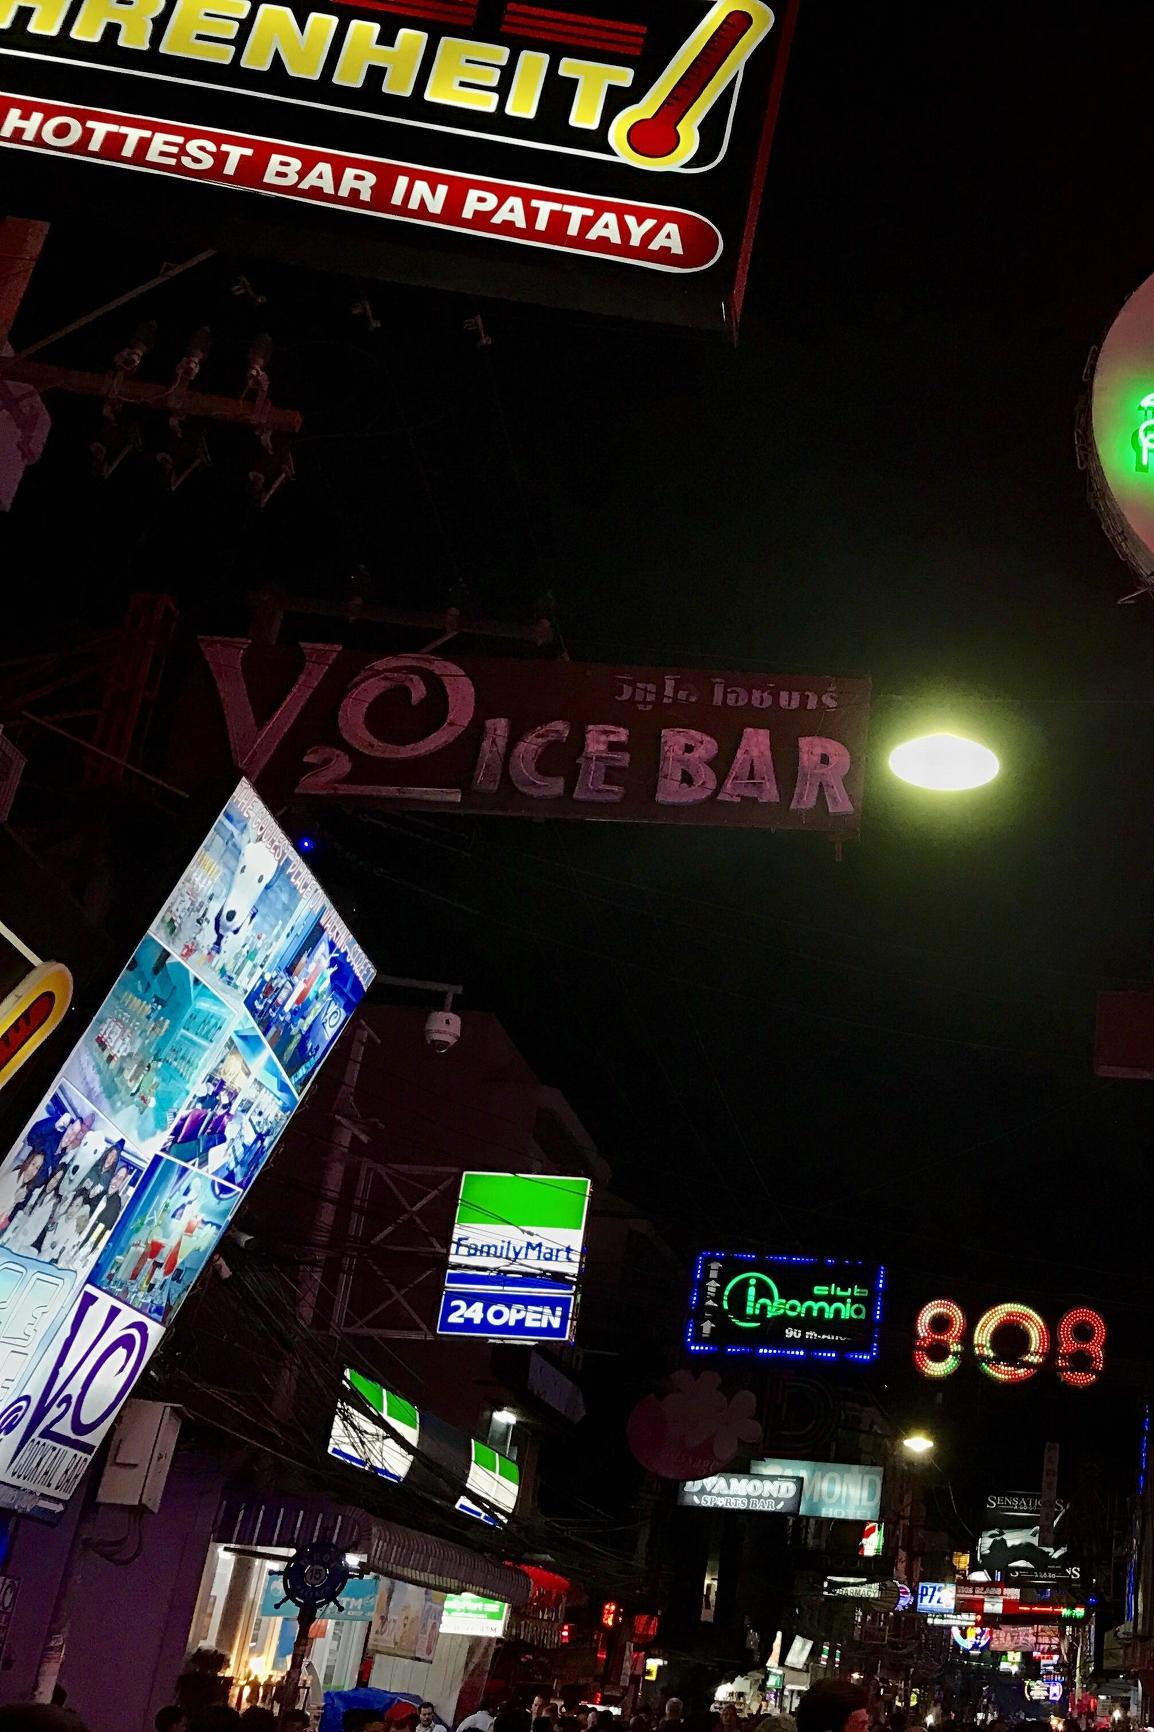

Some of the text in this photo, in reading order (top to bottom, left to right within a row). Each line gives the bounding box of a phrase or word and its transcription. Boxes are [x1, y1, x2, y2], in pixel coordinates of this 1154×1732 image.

[0, 107, 685, 255] HOTTEST BAR IN PATTAYA
[469, 718, 630, 801] ICE
[655, 727, 855, 814] BAR
[454, 1236, 574, 1262] FamilyMart
[744, 1277, 867, 1320] insomnia
[812, 1283, 869, 1297] club
[448, 1300, 562, 1329] 24 OPEN
[11, 1438, 88, 1495] COCKTAIL BAR
[749, 1497, 776, 1510] BAR
[986, 1495, 1065, 1513] SENSATIS
[330, 1596, 362, 1611] TM
